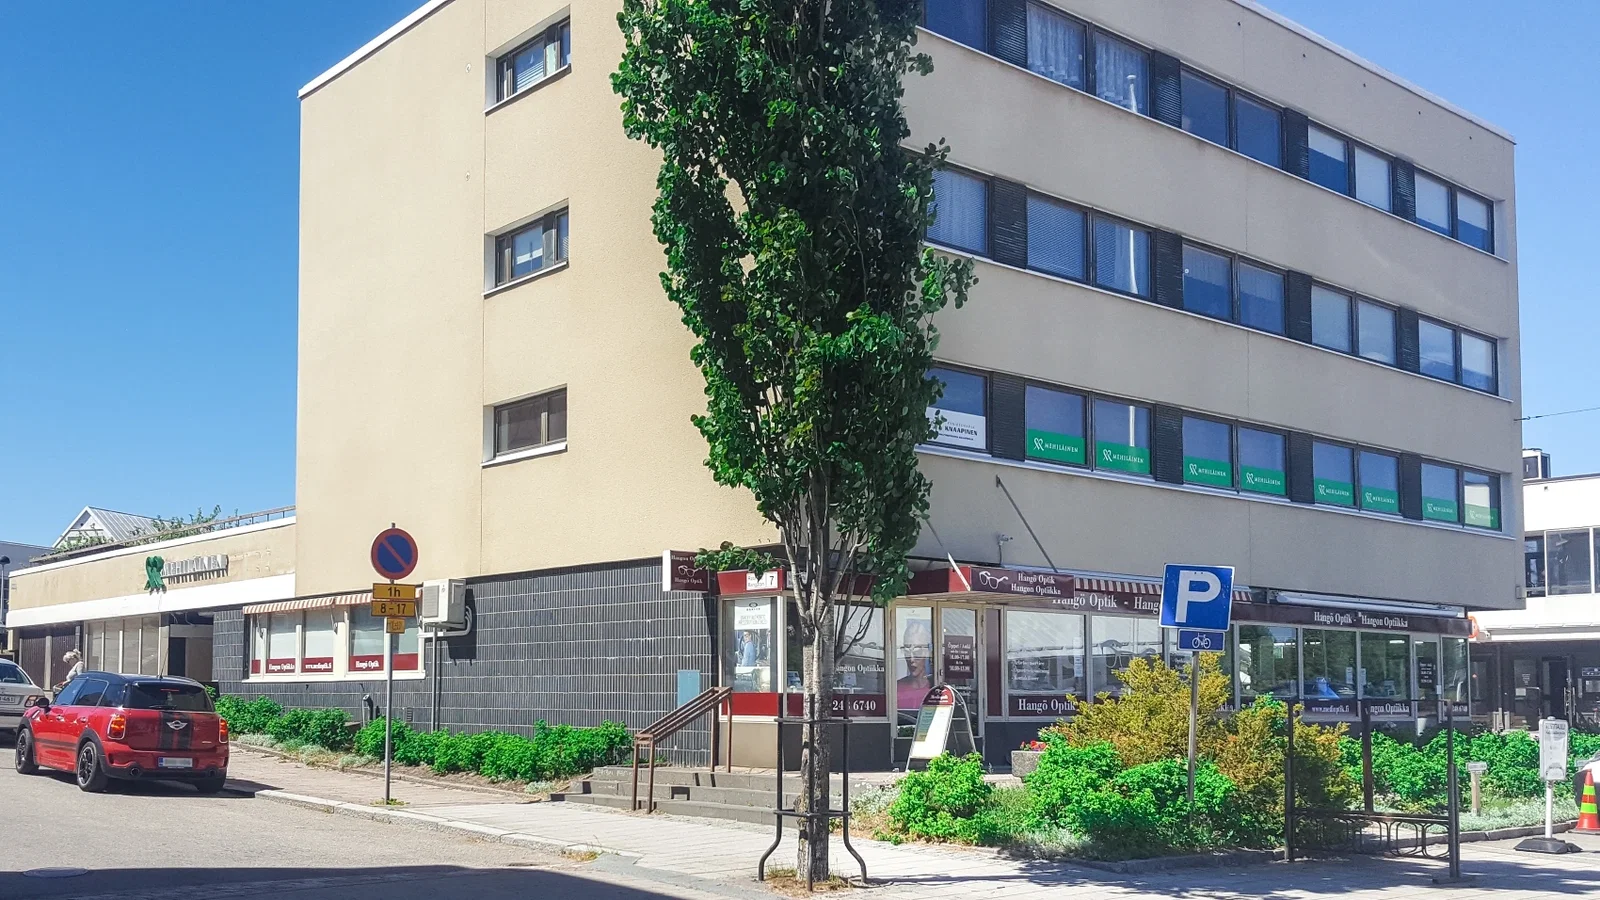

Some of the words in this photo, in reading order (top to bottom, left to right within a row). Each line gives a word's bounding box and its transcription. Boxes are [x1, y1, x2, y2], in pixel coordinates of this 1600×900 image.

[944, 425, 978, 436] KNAAPINEN
[1044, 443, 1079, 453] MEHILÄINEN
[1112, 453, 1144, 463] MEHILÄINEN
[1198, 468, 1226, 477] MEHILÄINEN
[1254, 477, 1281, 486] MEHILÄINEN
[769, 575, 774, 586] 7
[1018, 573, 1037, 584] Hangö
[1038, 575, 1055, 585] Optik
[388, 587, 400, 597] 1h
[1011, 583, 1034, 593] Hangon
[1036, 584, 1061, 595] Optiikka
[1175, 570, 1221, 622] P
[1089, 593, 1118, 611] Optik
[1314, 612, 1334, 624] Hangö
[1335, 613, 1352, 626] Optik
[1361, 616, 1383, 628] Hangon
[1384, 617, 1408, 629] Optiikka
[835, 665, 856, 674] angon
[857, 664, 885, 675] Optiikka
[853, 700, 876, 711] 6740
[1018, 699, 1048, 714] Hangö
[1051, 699, 1076, 714] Optik
[1385, 703, 1410, 715] Optiikka
